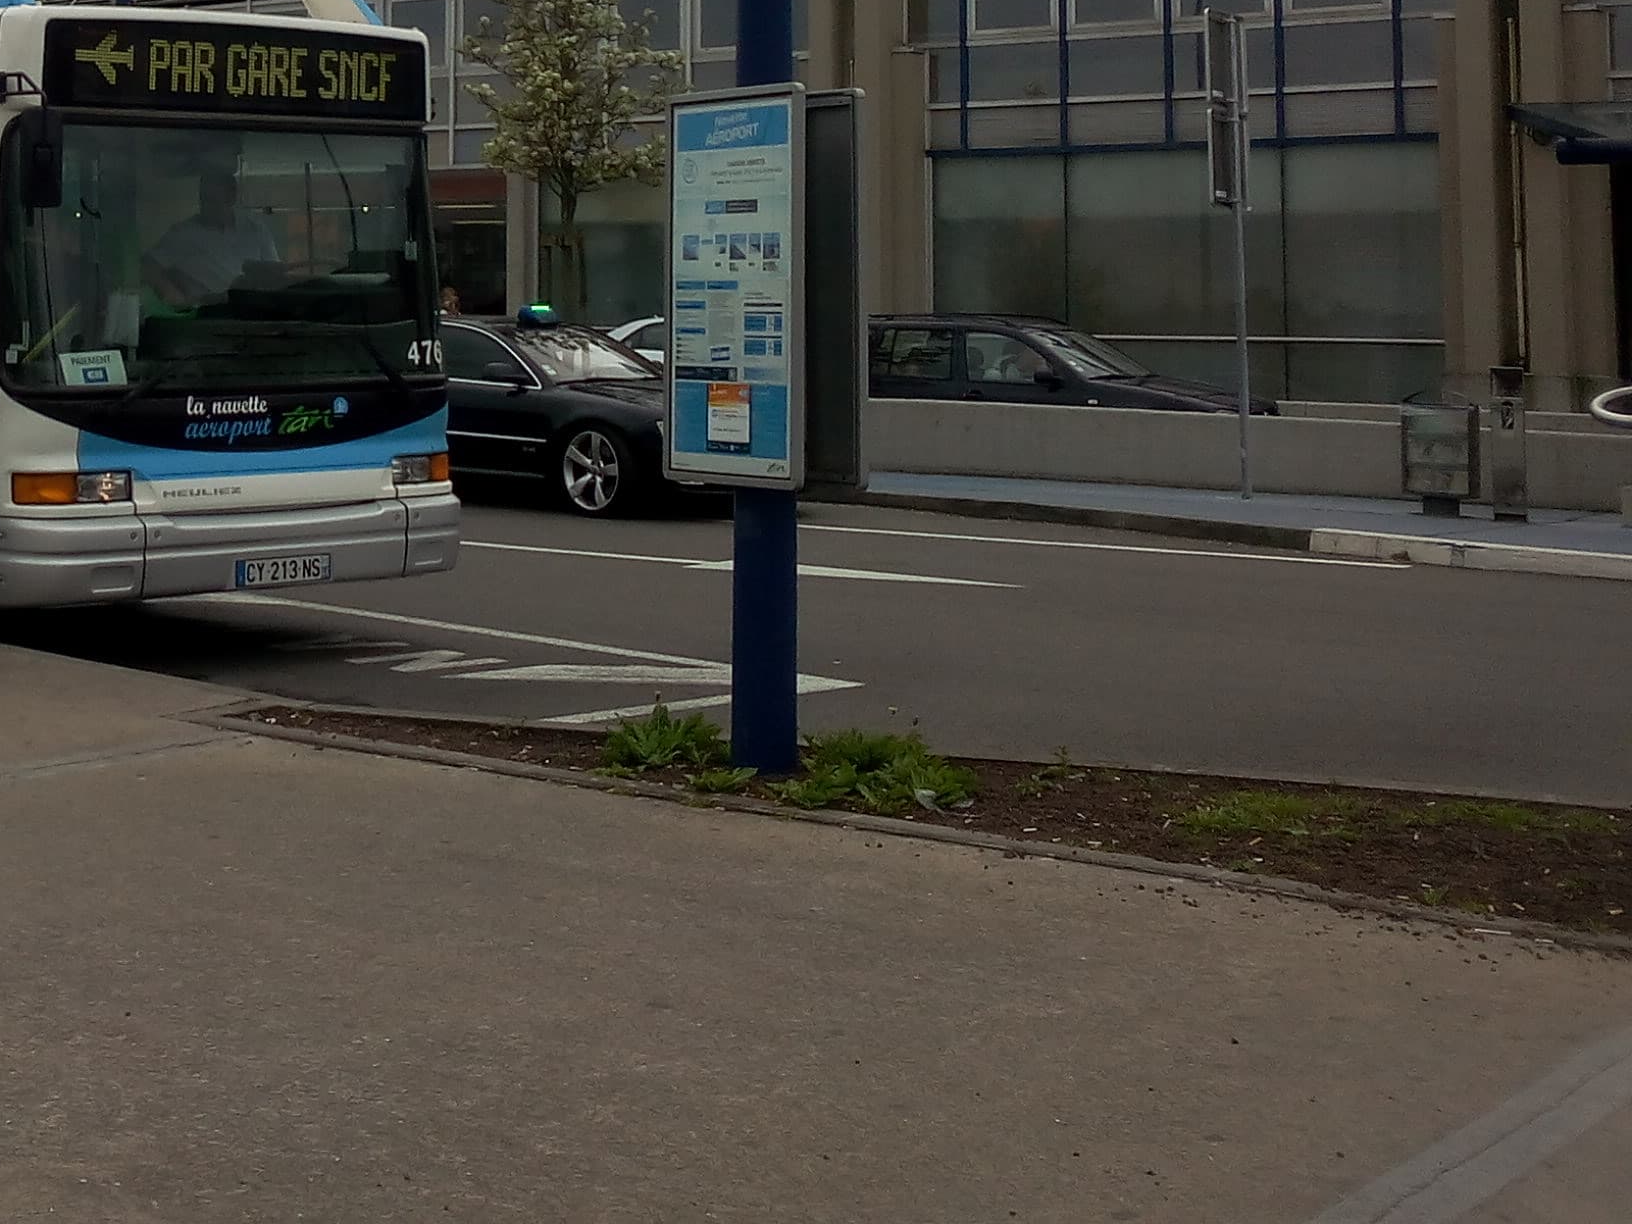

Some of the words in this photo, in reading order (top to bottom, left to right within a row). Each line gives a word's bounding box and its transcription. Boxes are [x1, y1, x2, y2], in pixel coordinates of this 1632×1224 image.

[148, 39, 215, 95] PAR
[226, 42, 309, 98] GARE
[318, 49, 397, 102] SNCF
[407, 339, 443, 366] 476
[186, 395, 206, 416] la
[212, 395, 268, 415] navette
